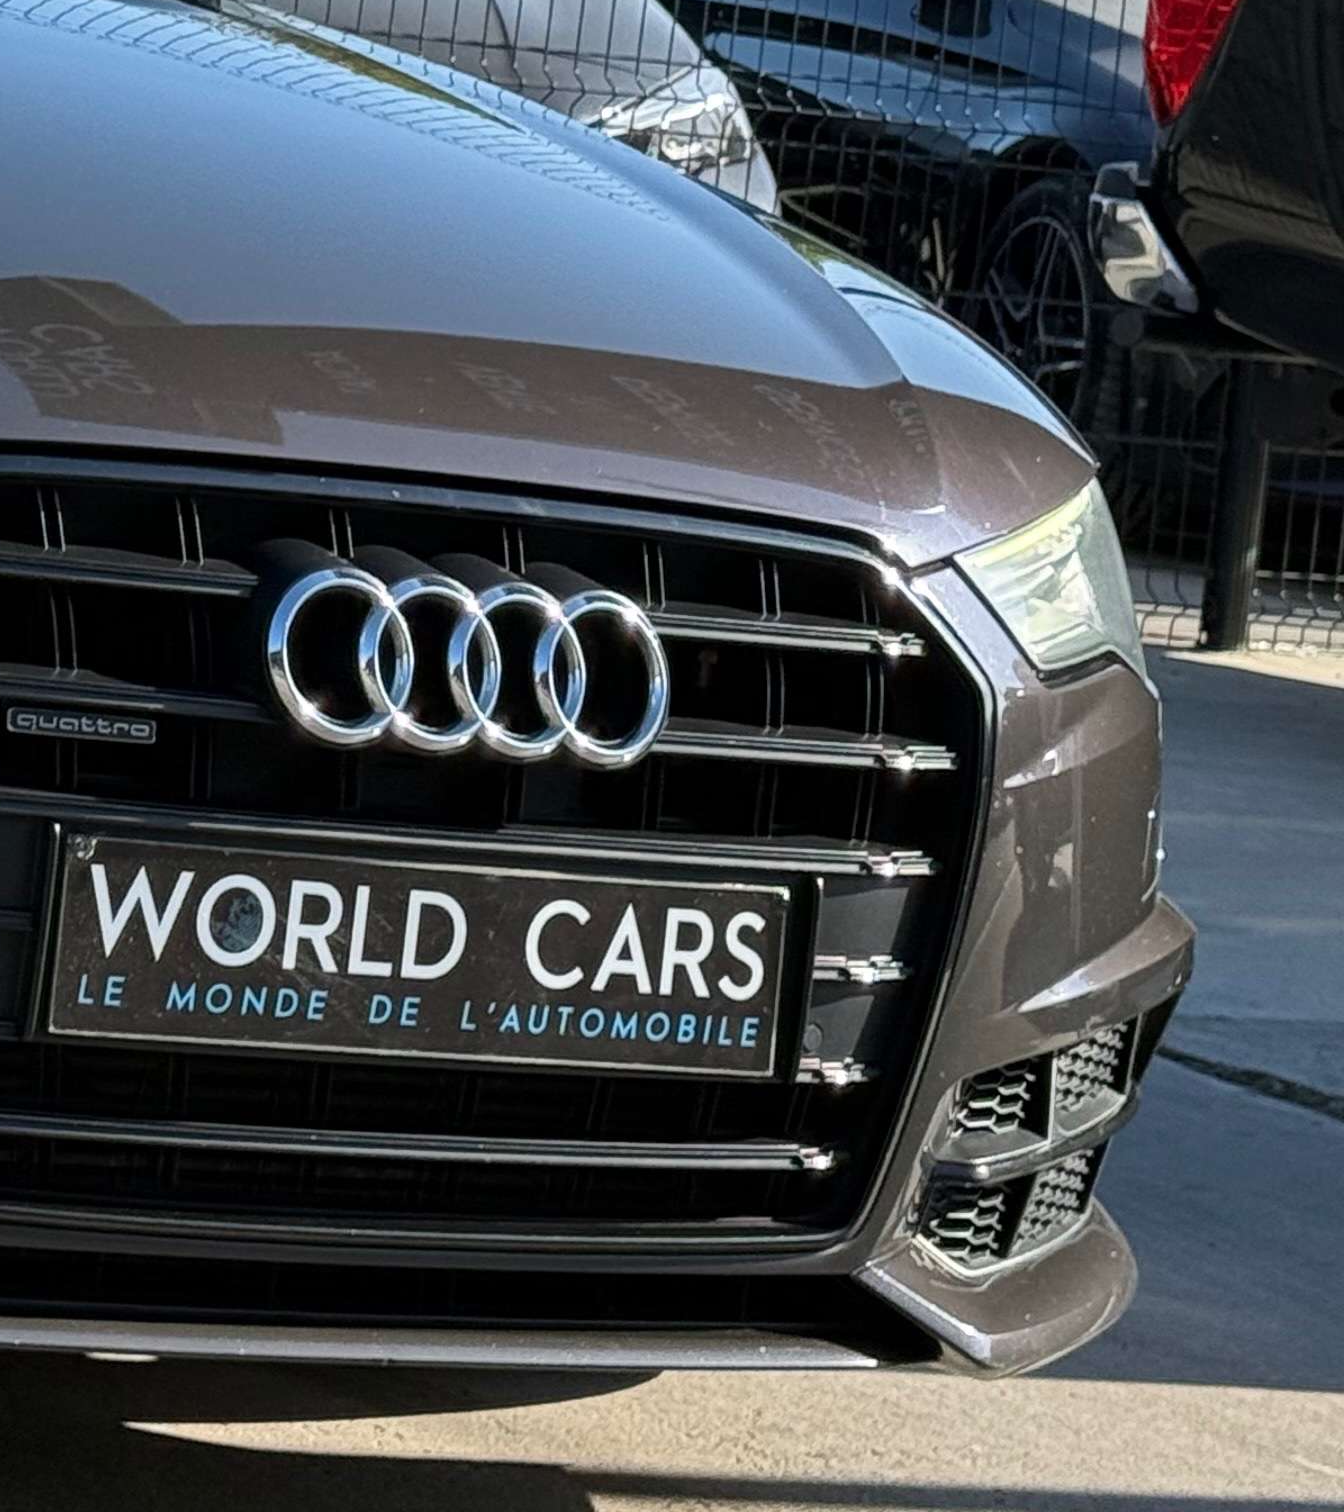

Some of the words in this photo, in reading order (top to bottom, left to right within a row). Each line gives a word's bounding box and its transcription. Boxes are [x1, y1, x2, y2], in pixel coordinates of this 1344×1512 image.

[16, 713, 150, 737] quattro
[90, 863, 468, 981] WORLD
[525, 898, 767, 1002] CARS
[77, 974, 126, 1007] LE
[166, 981, 328, 1022] MONDE
[369, 995, 421, 1028] DE
[460, 1001, 761, 1048] L'AUTOMOBILE
